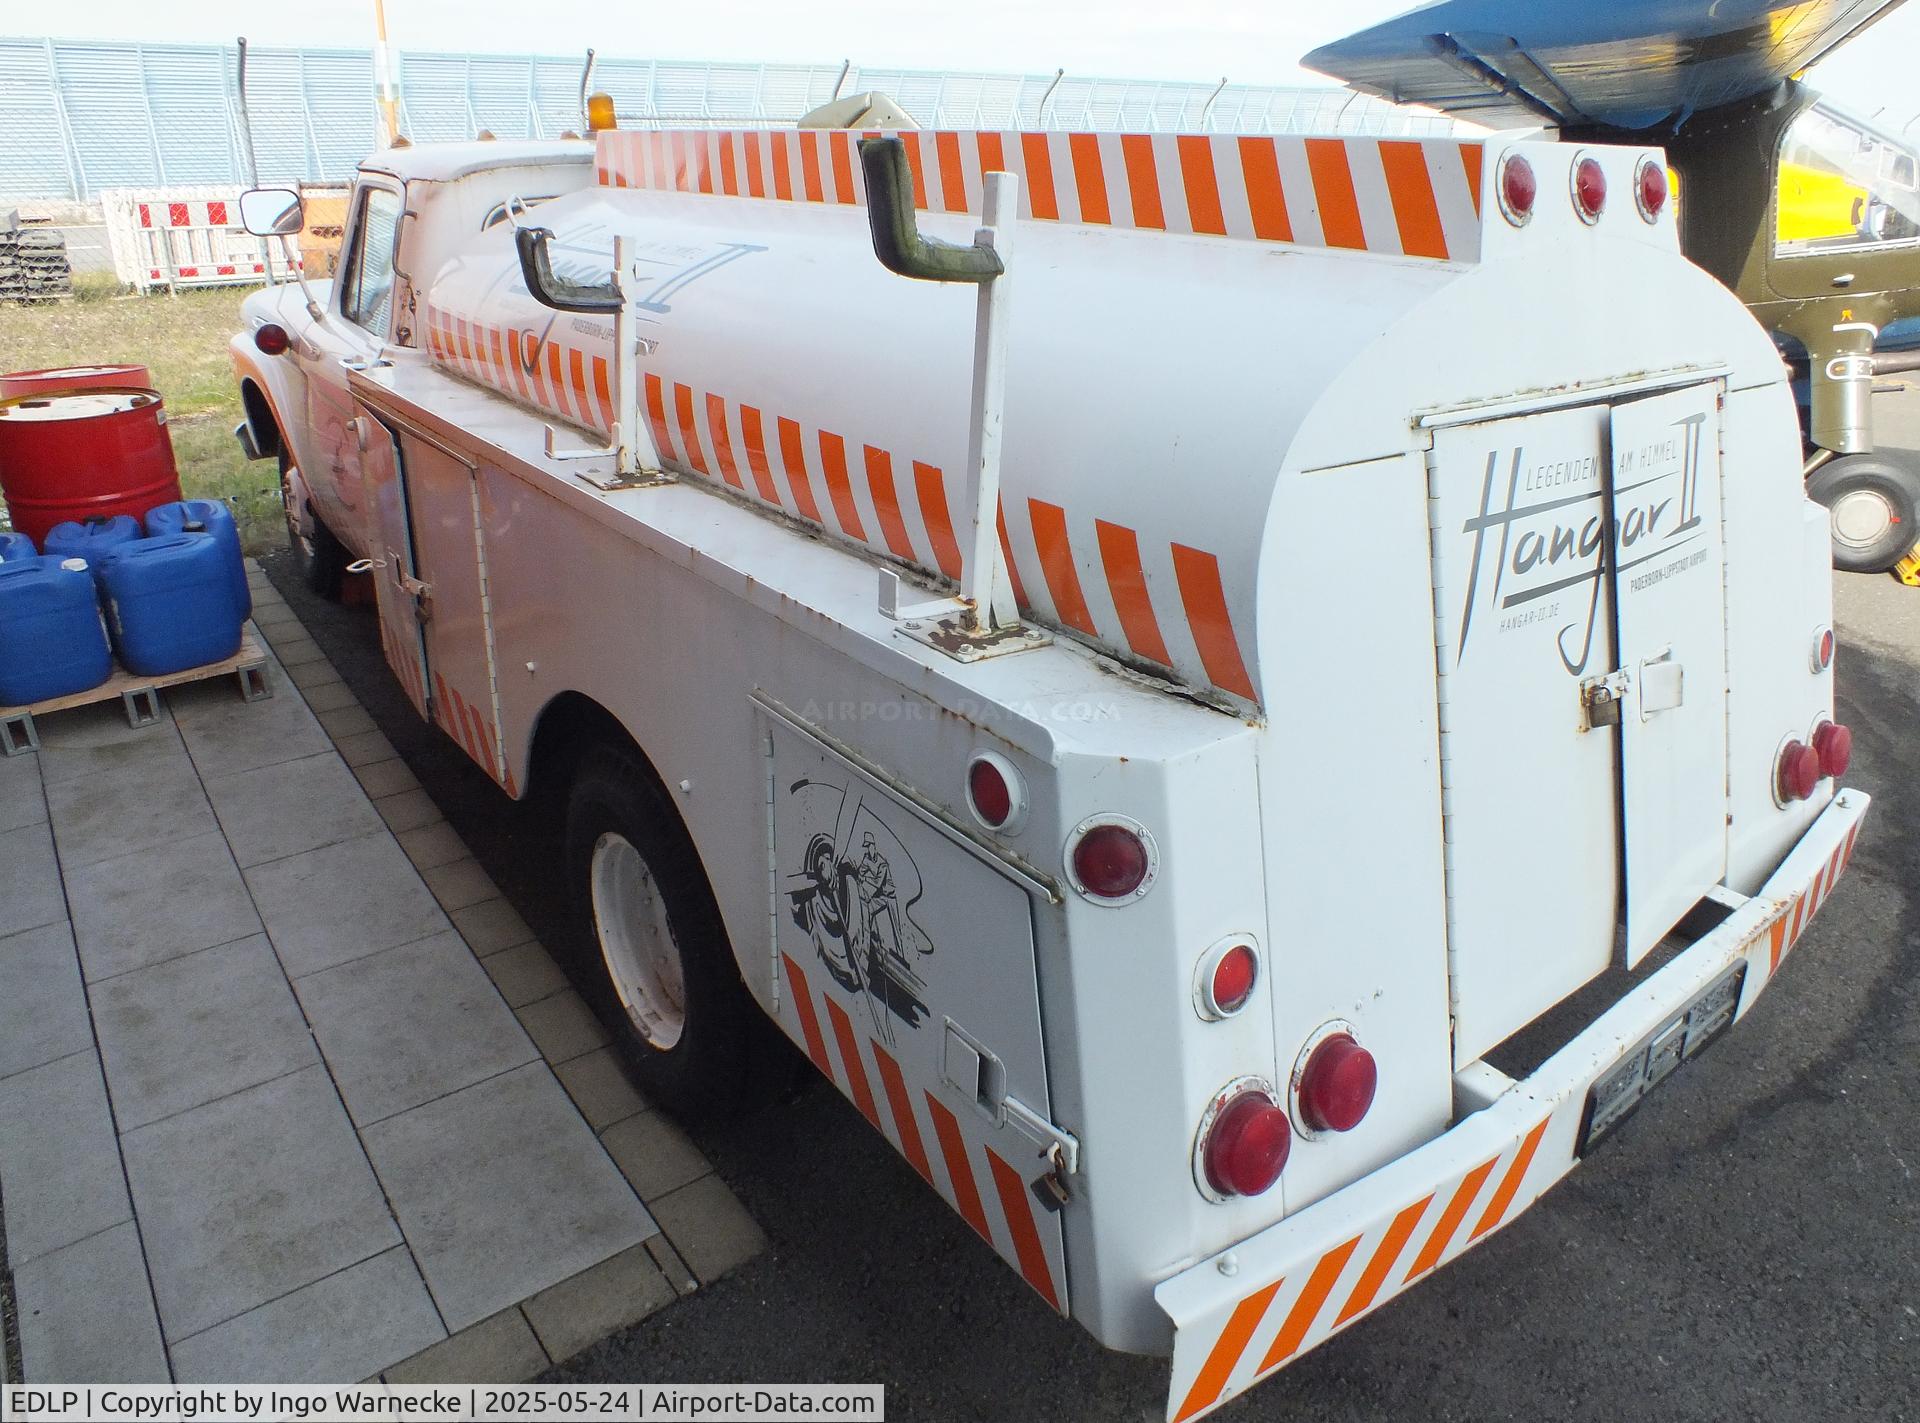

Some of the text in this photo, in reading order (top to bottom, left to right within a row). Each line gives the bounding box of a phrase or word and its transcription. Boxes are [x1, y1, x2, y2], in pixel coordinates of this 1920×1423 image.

[1526, 439, 1678, 492] LEGENDEN AM HIMMEL
[1456, 446, 1673, 677] Hangar
